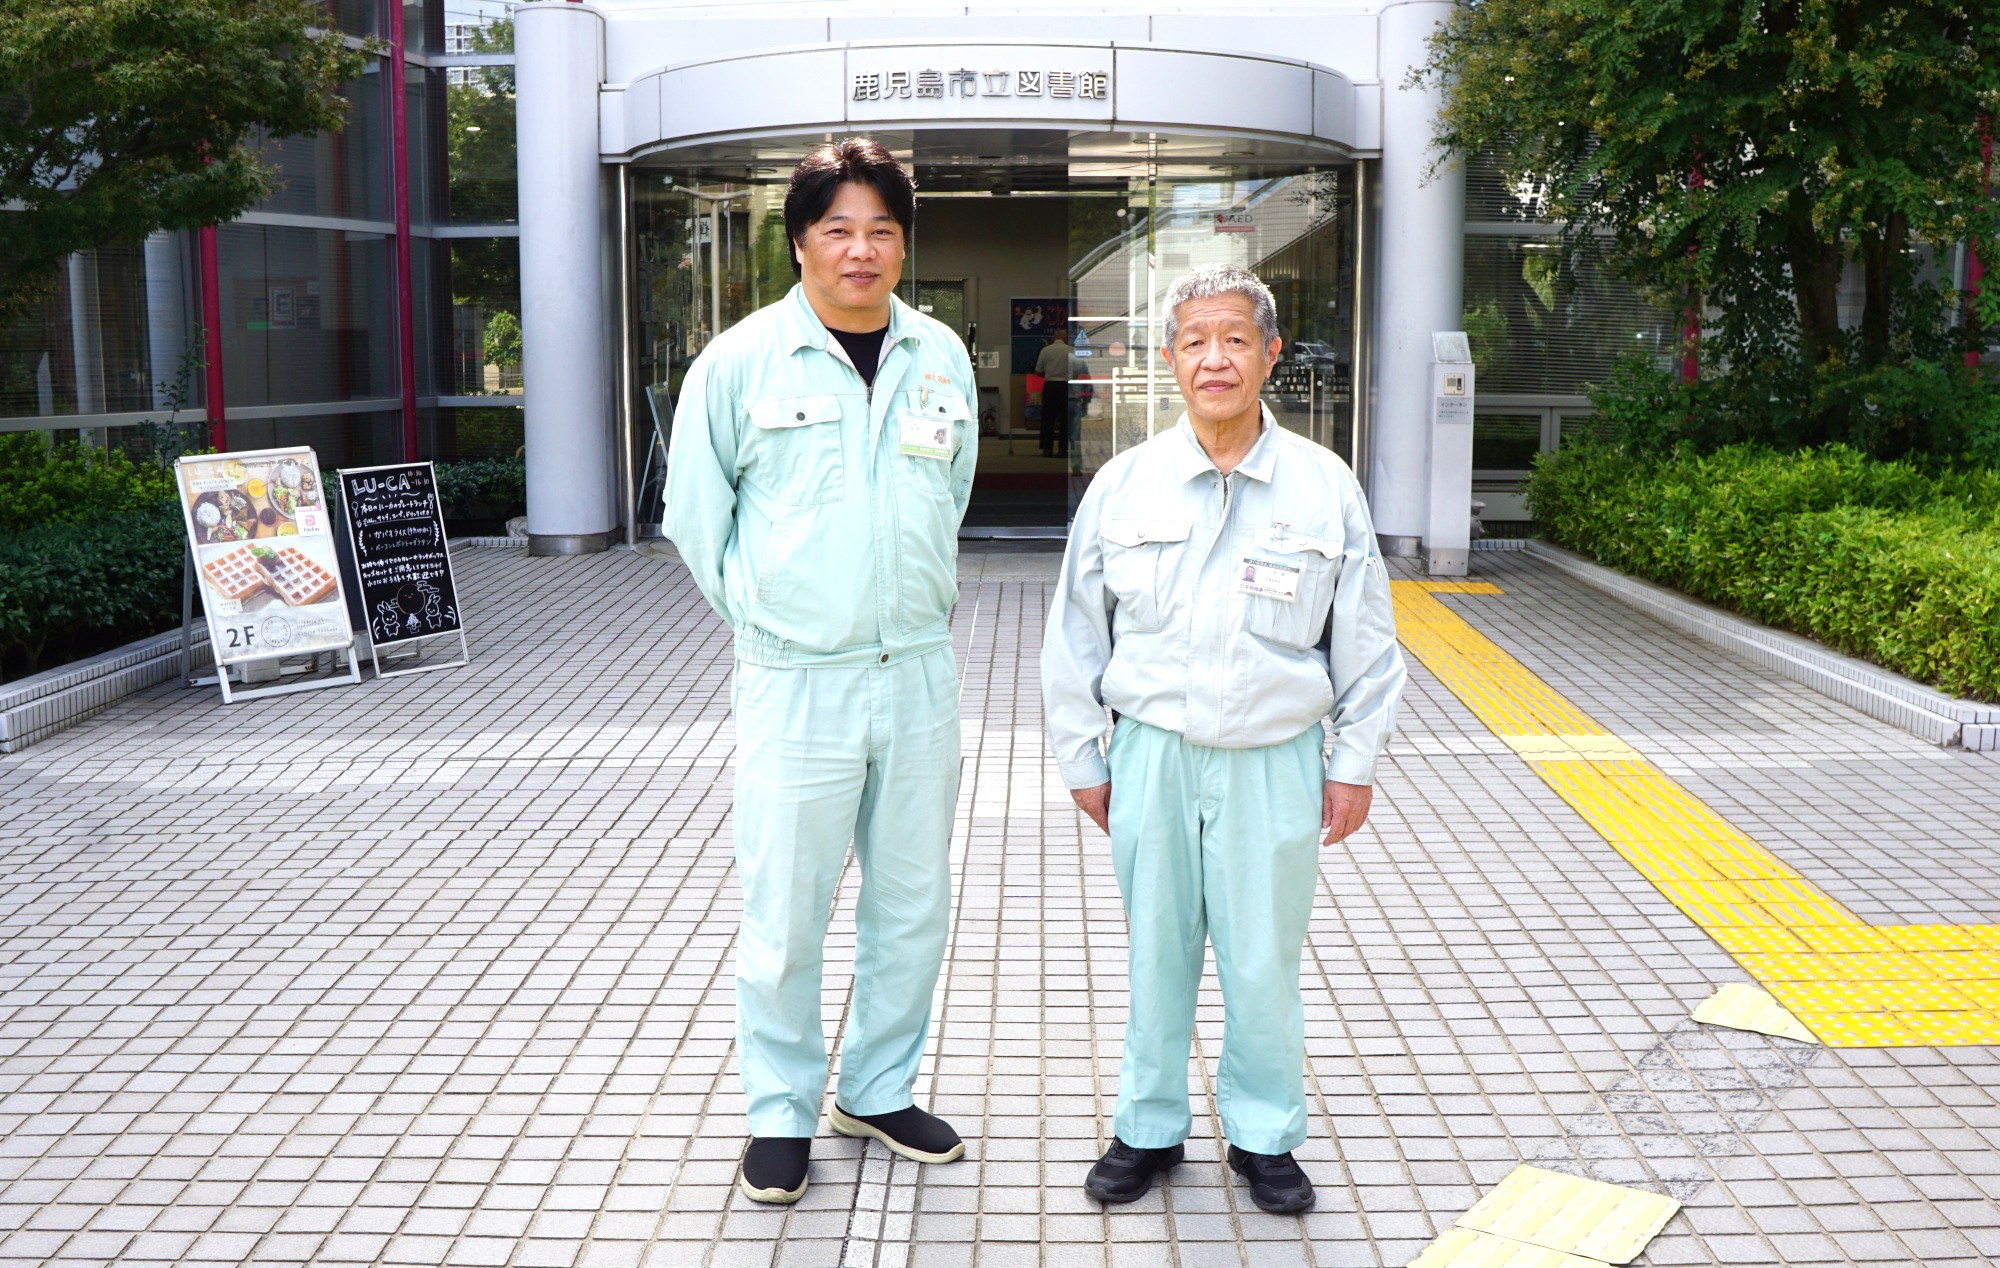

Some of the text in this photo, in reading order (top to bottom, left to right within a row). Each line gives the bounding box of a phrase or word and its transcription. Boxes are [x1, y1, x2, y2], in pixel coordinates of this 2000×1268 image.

[852, 67, 1110, 101] 鹿児島市立図書館
[1229, 214, 1253, 223] AED
[351, 473, 411, 496] LU-CA
[226, 625, 255, 648] 2F
